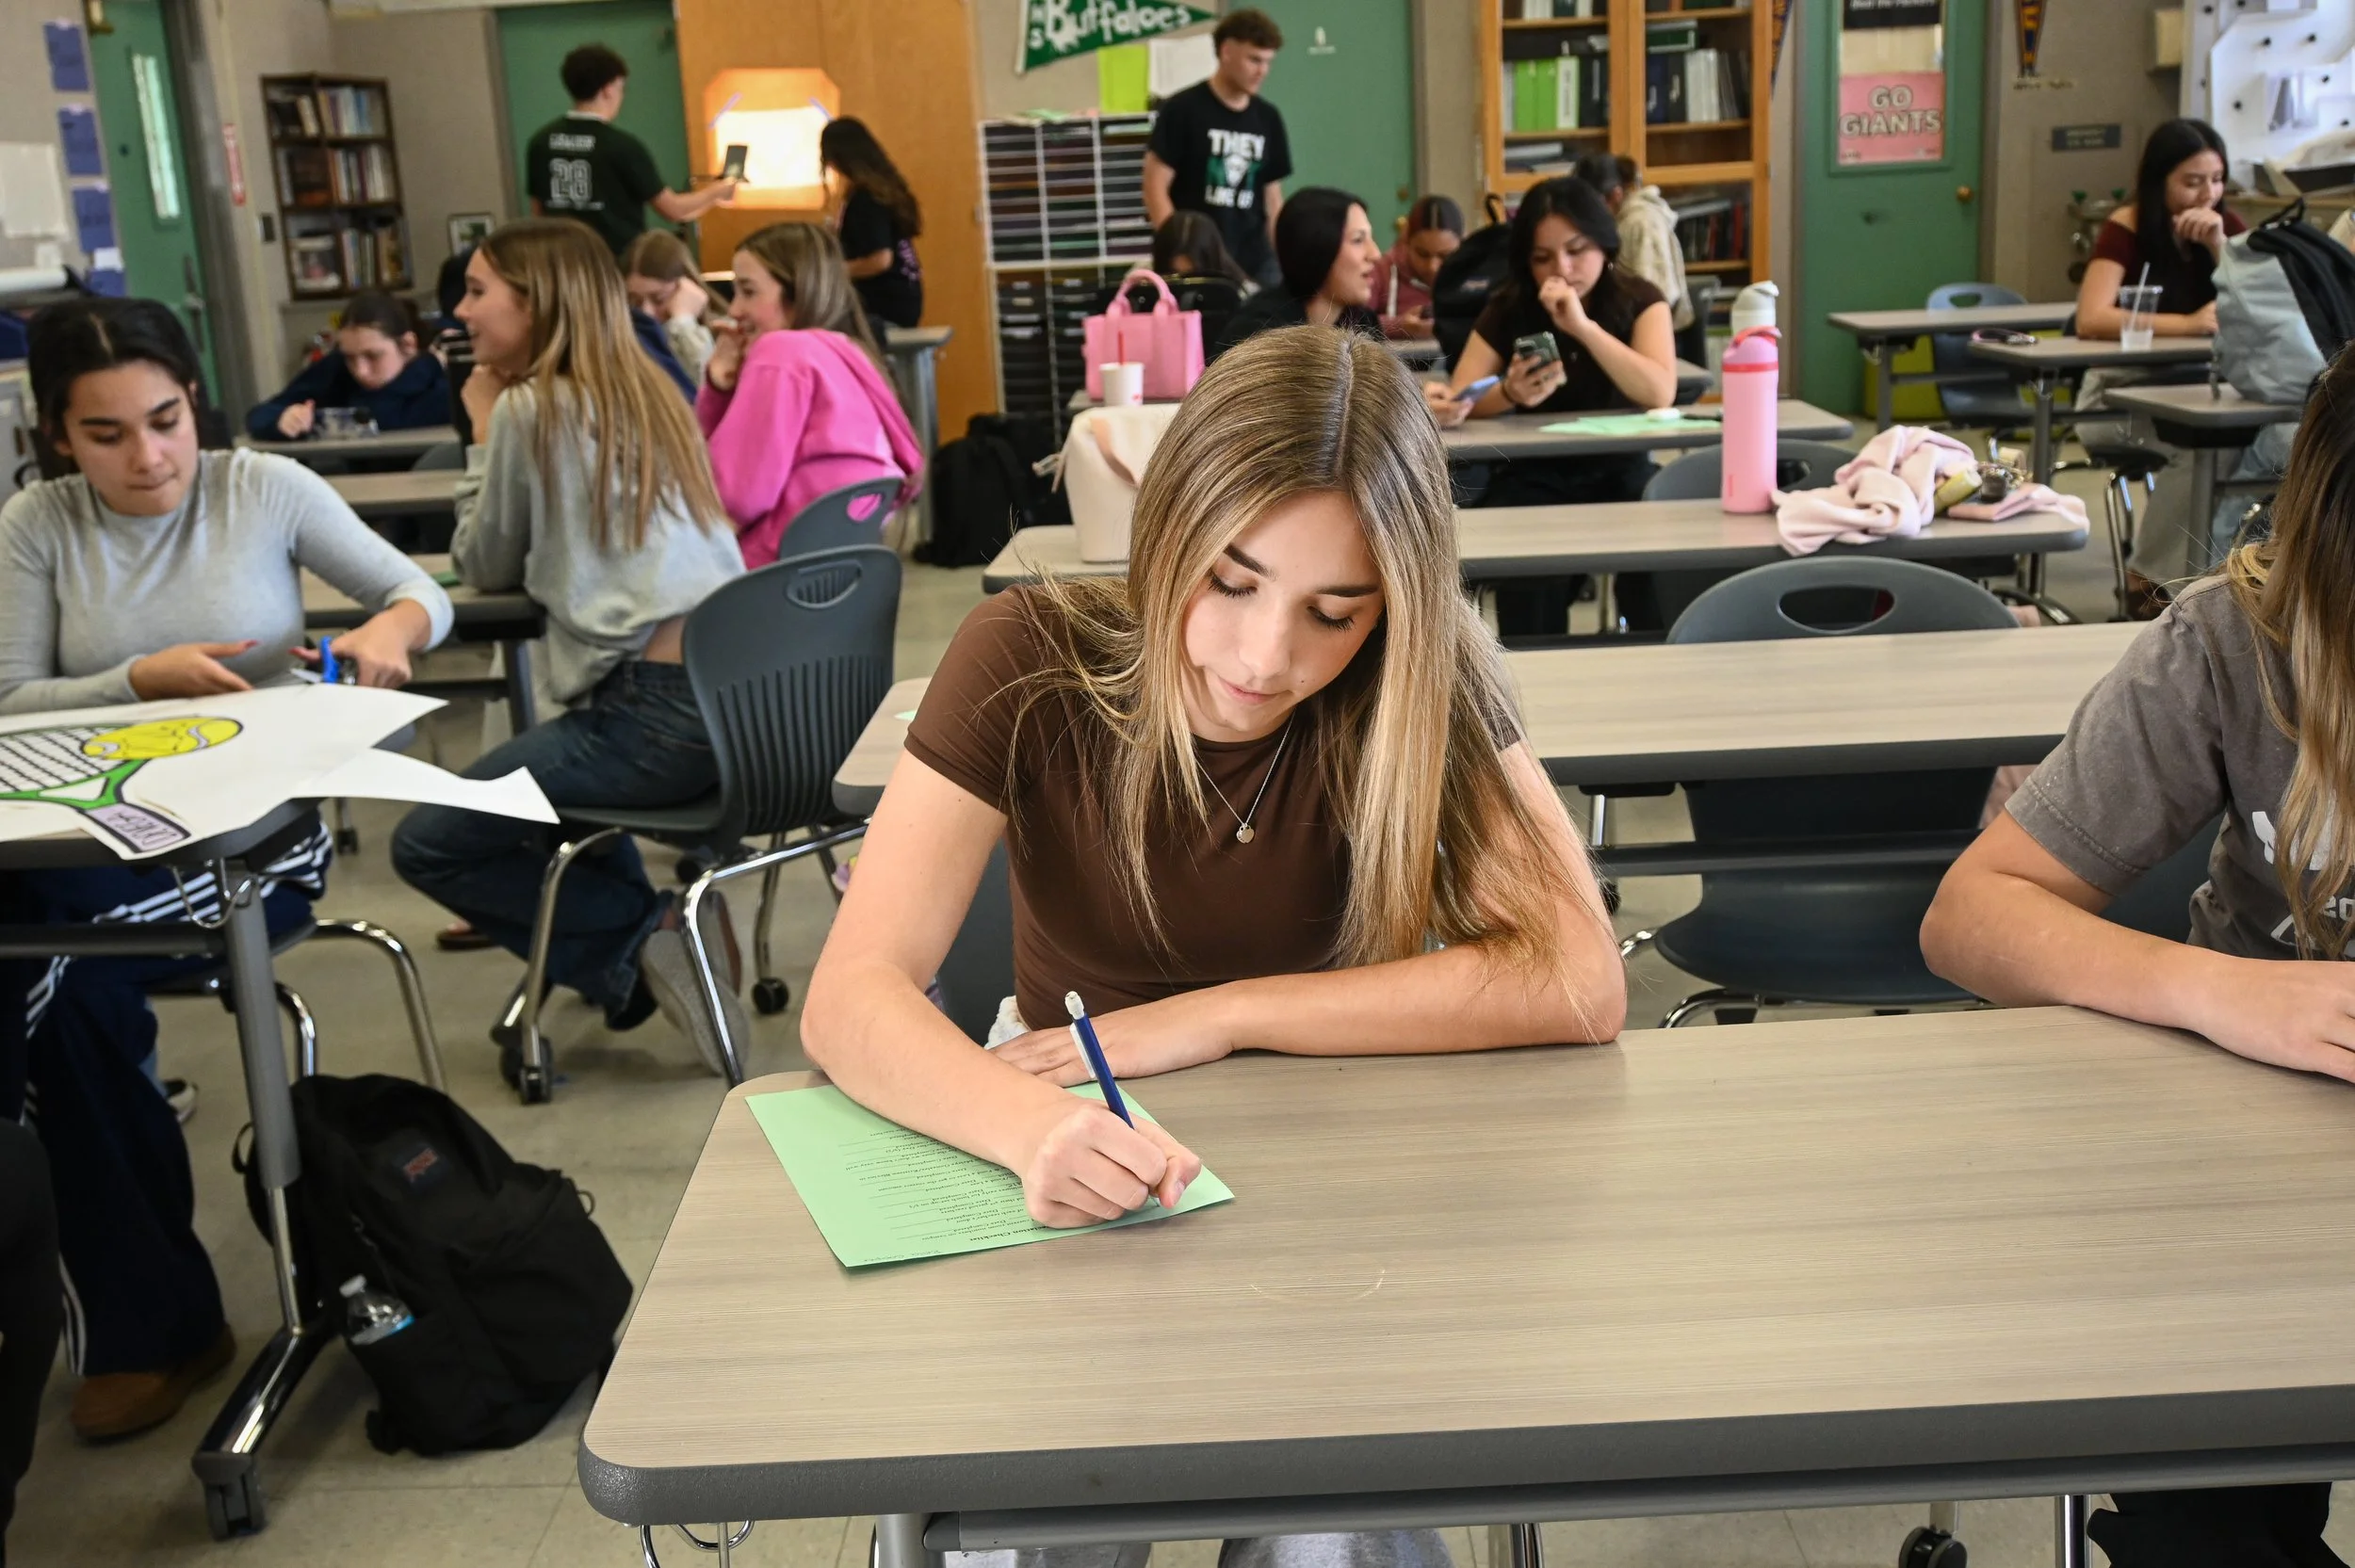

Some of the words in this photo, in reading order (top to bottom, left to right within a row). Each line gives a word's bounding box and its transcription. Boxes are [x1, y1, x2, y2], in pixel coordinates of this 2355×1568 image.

[1868, 85, 1913, 111] GO
[1840, 109, 1941, 138] GIANTS
[1207, 128, 1265, 161] THEY
[939, 1203, 974, 1211] Completed
[946, 1213, 982, 1221] Completed
[969, 1233, 1011, 1241] Checklist
